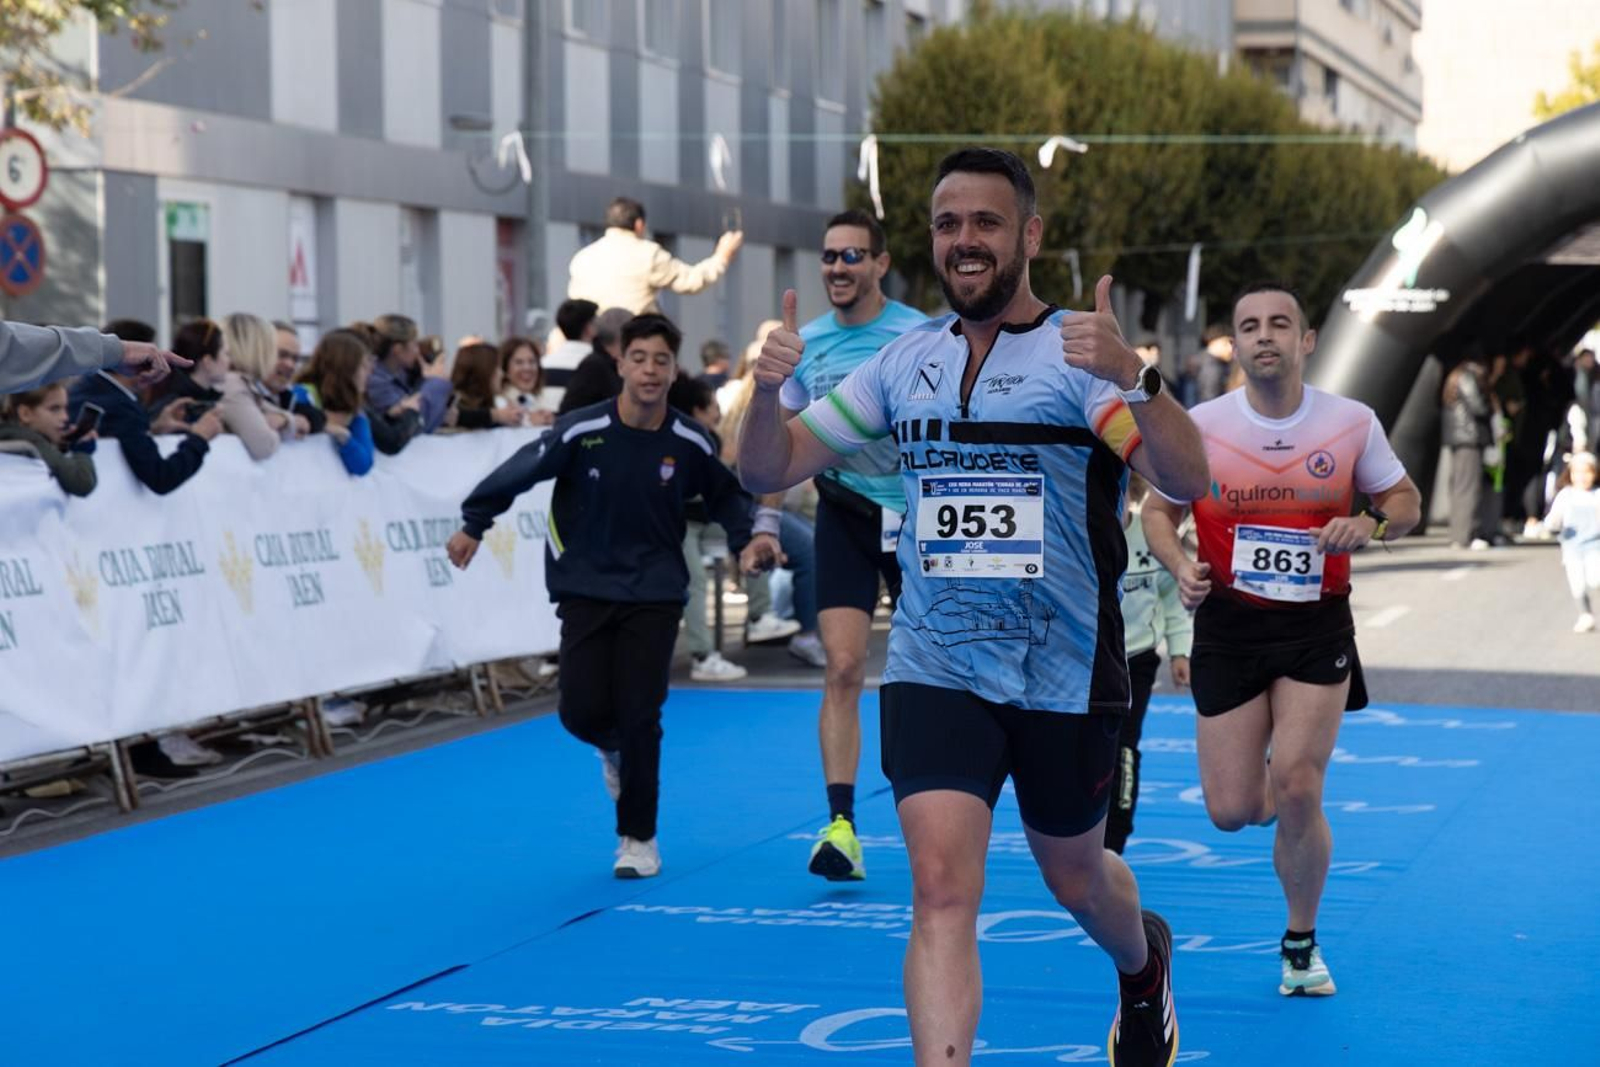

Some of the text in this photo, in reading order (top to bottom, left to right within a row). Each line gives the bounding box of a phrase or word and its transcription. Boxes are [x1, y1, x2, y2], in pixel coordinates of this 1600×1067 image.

[901, 449, 1039, 471] ALCAUDETE
[386, 519, 422, 552] CAJ
[937, 504, 1017, 538] 953
[99, 541, 205, 587] CAJA RURAL
[1252, 547, 1311, 575] 863
[0, 558, 43, 598] RAL
[141, 583, 184, 630] JAÉN
[480, 1016, 732, 1034] MEDIA
